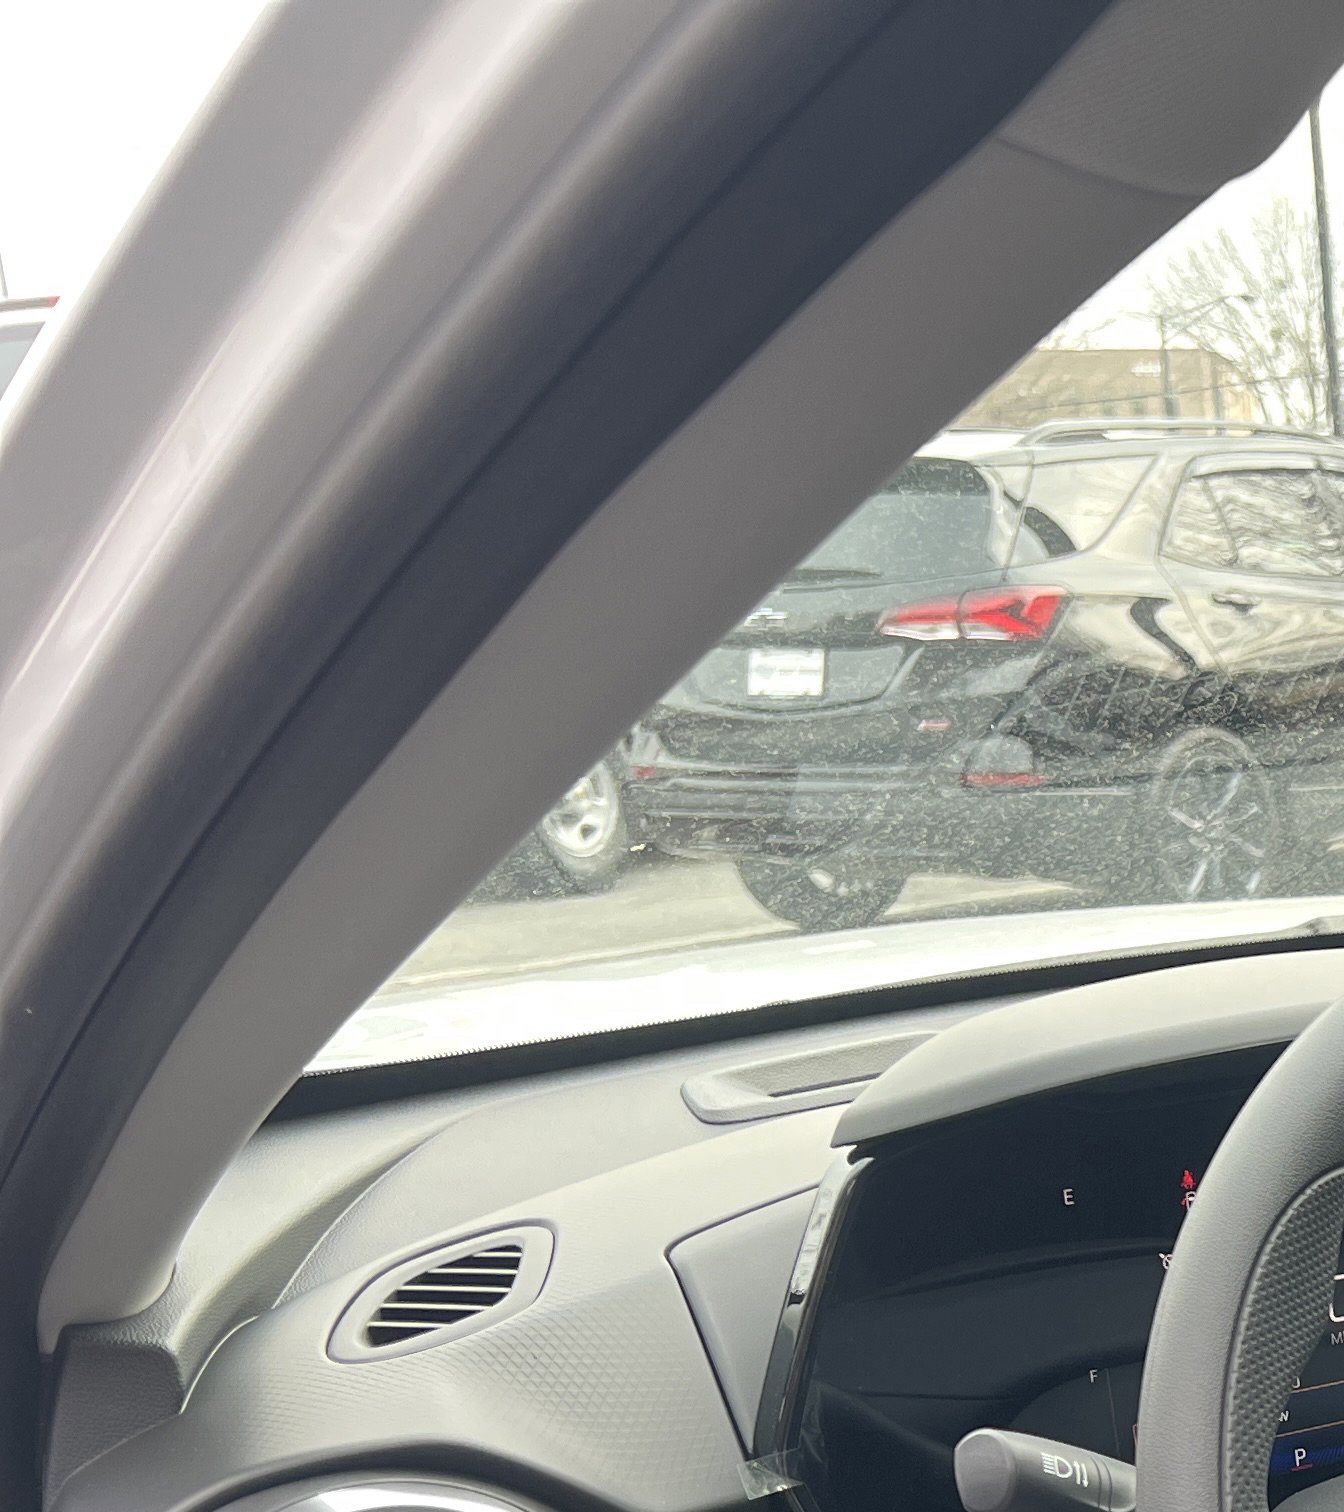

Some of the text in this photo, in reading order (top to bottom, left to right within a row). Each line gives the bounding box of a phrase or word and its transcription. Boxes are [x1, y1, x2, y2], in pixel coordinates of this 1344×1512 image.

[1063, 1188, 1075, 1206] E
[1089, 1369, 1098, 1383] F
[1295, 1448, 1306, 1467] P
